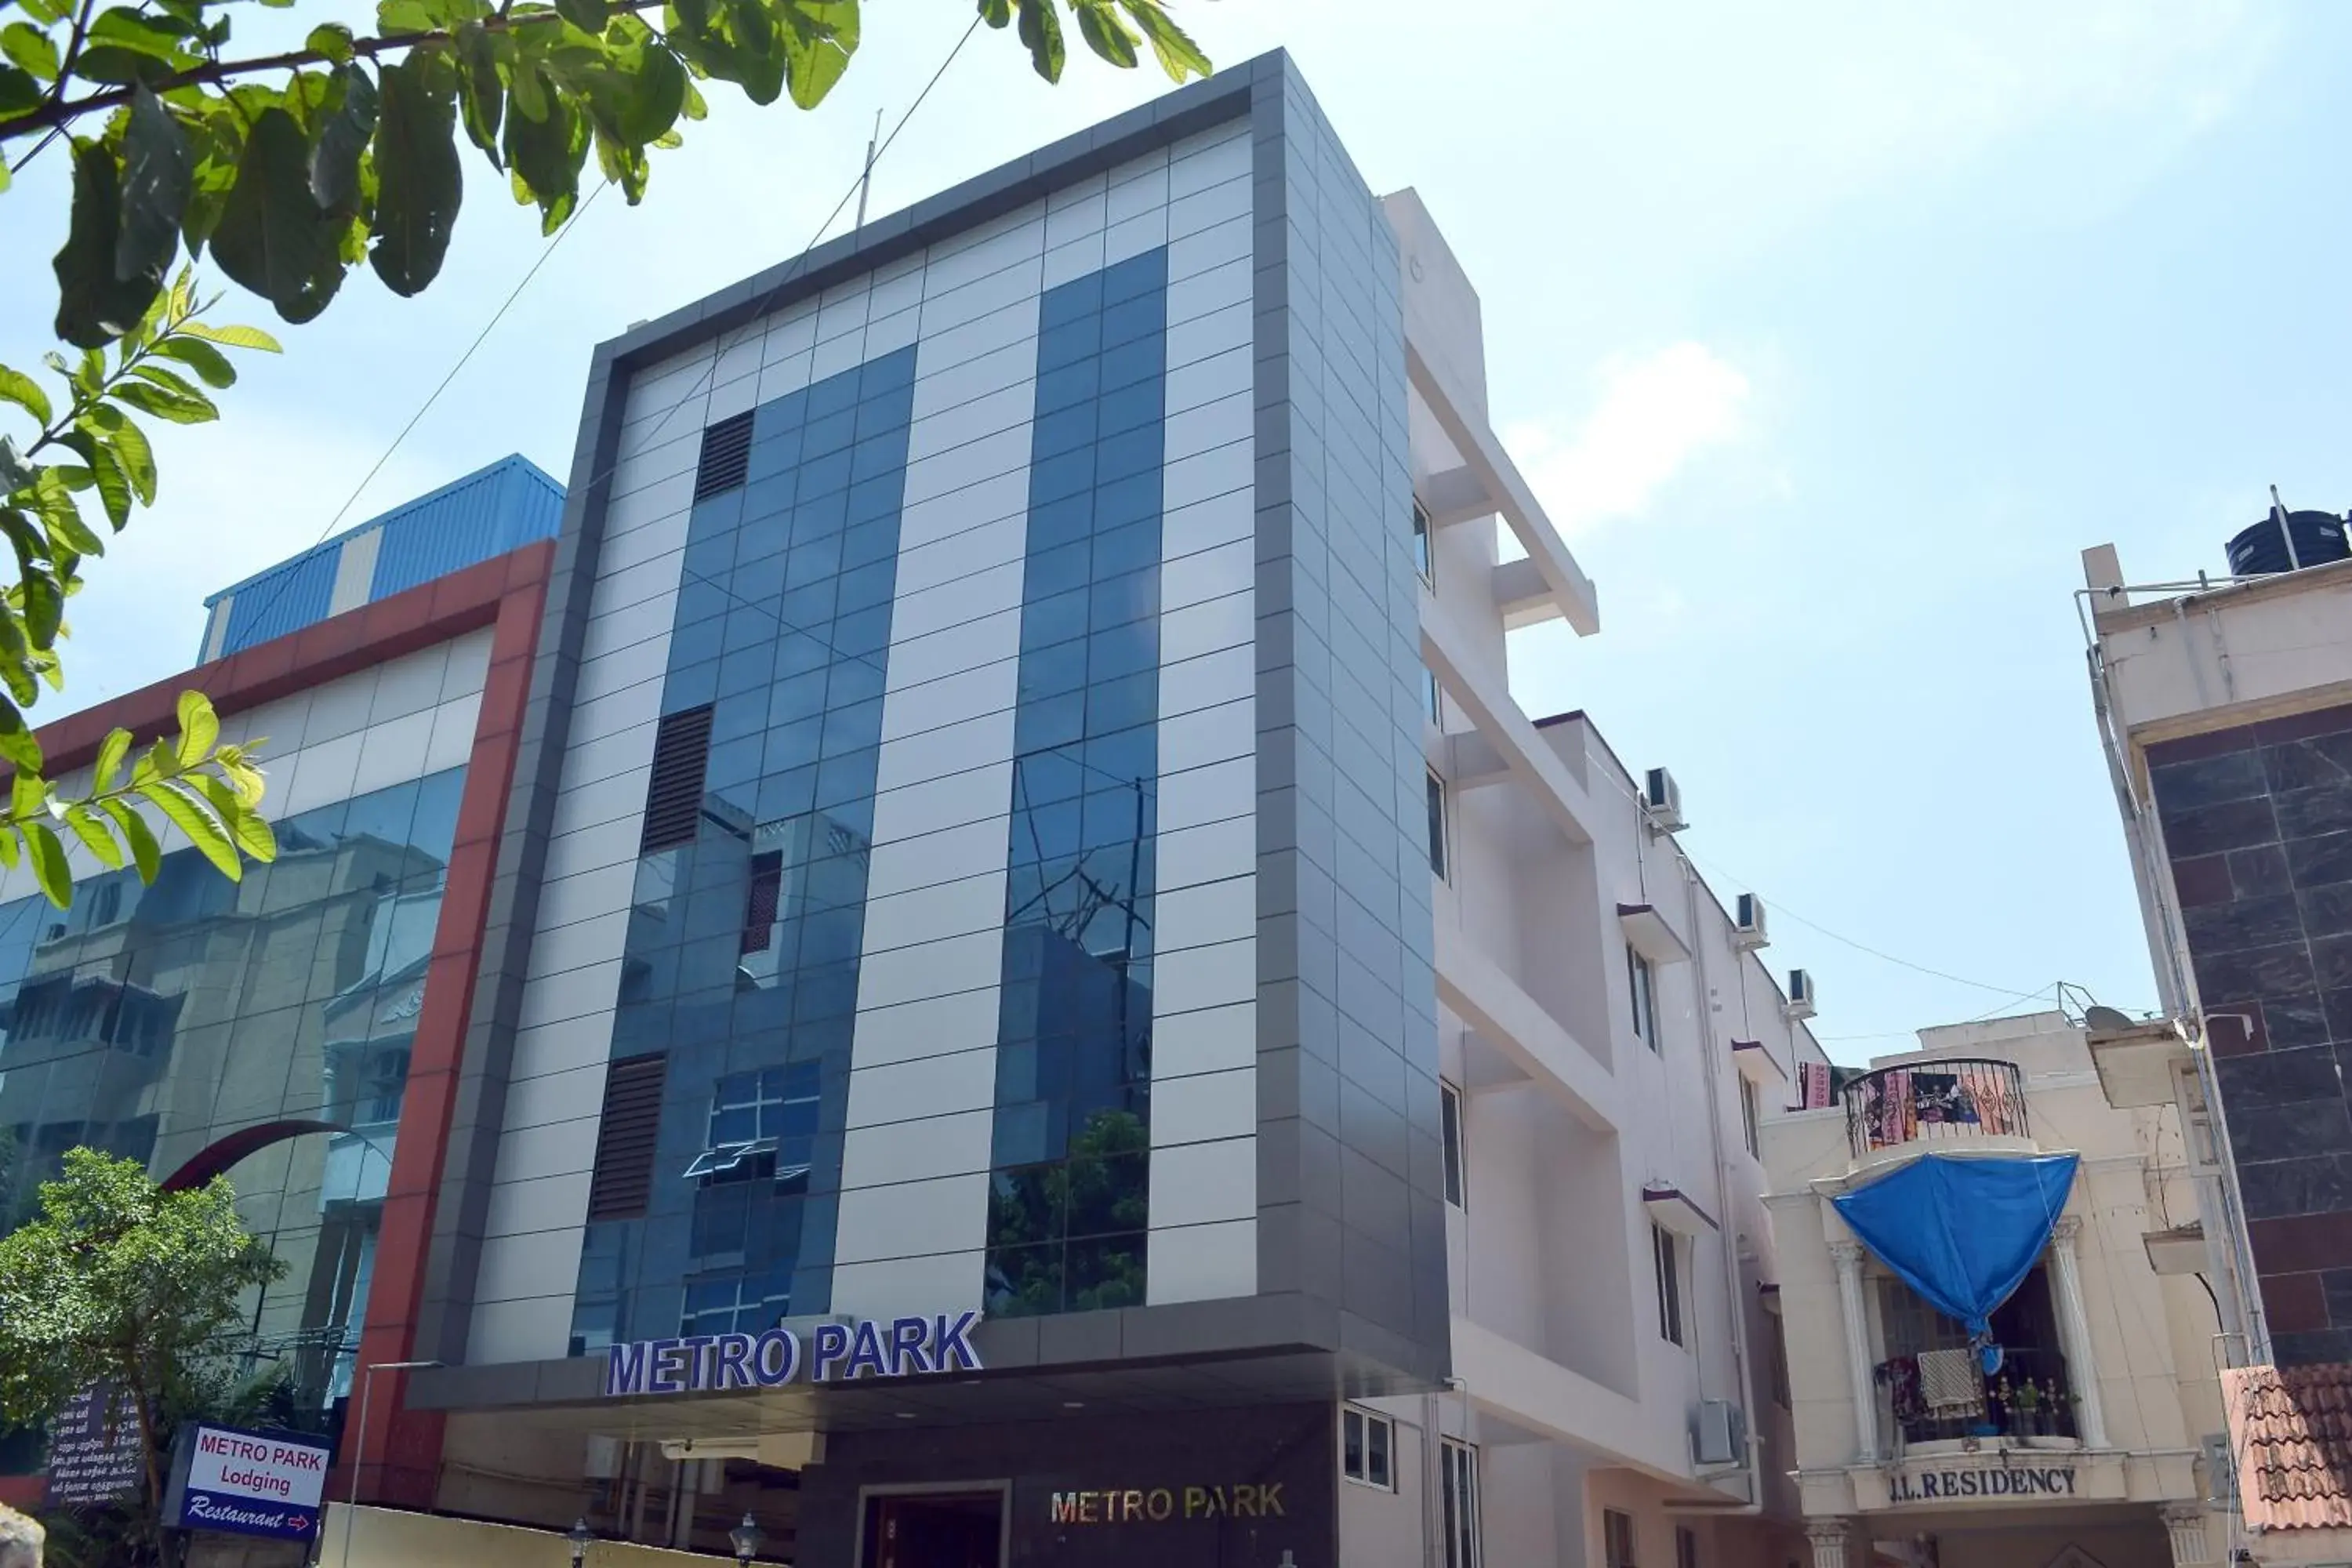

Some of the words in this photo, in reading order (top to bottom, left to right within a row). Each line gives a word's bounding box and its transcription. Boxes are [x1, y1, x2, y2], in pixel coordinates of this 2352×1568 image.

[606, 1328, 800, 1396] METRO
[812, 1309, 983, 1382] PARK
[201, 1434, 267, 1461] METRO
[272, 1448, 323, 1472] PARK
[220, 1465, 291, 1496] Lodging
[187, 1495, 285, 1528] Restaurant
[1051, 1488, 1174, 1523] METRO
[1184, 1482, 1286, 1519] PARK
